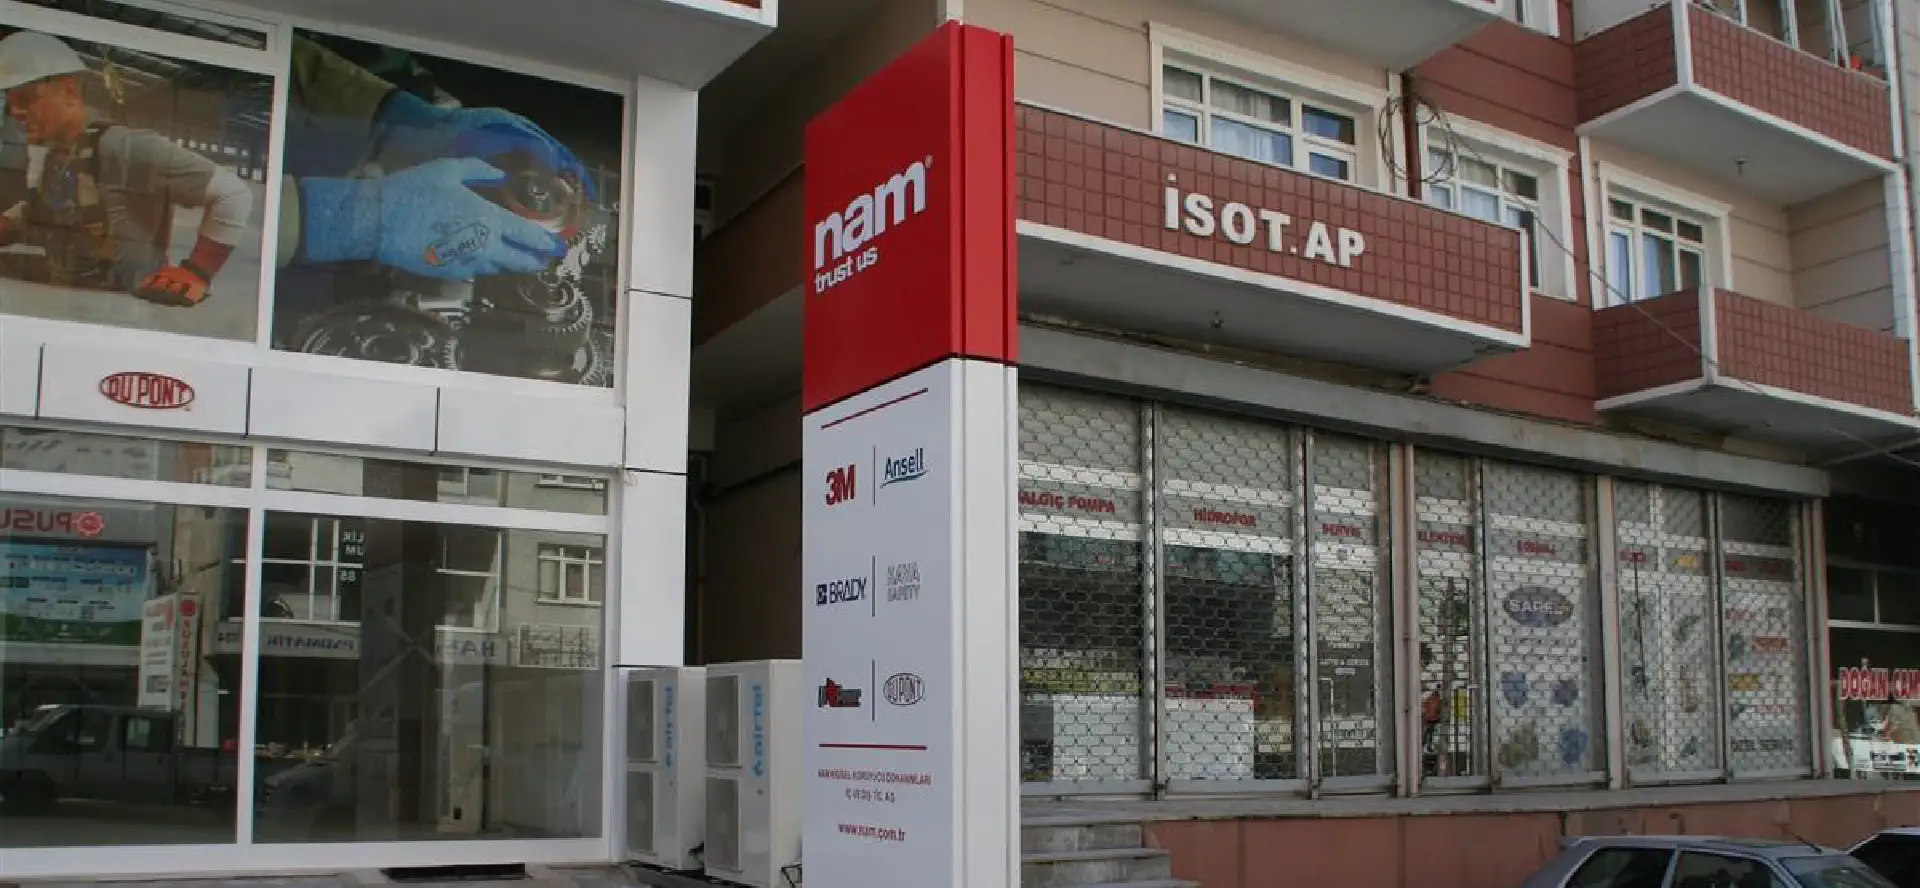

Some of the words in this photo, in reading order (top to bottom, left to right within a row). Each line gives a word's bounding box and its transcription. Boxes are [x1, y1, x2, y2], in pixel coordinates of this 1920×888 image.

[815, 161, 926, 269] nam
[815, 256, 854, 294] trust
[856, 246, 879, 272] us
[825, 464, 857, 505] 3M
[884, 447, 925, 480] Ansell
[829, 575, 868, 604] BRADY
